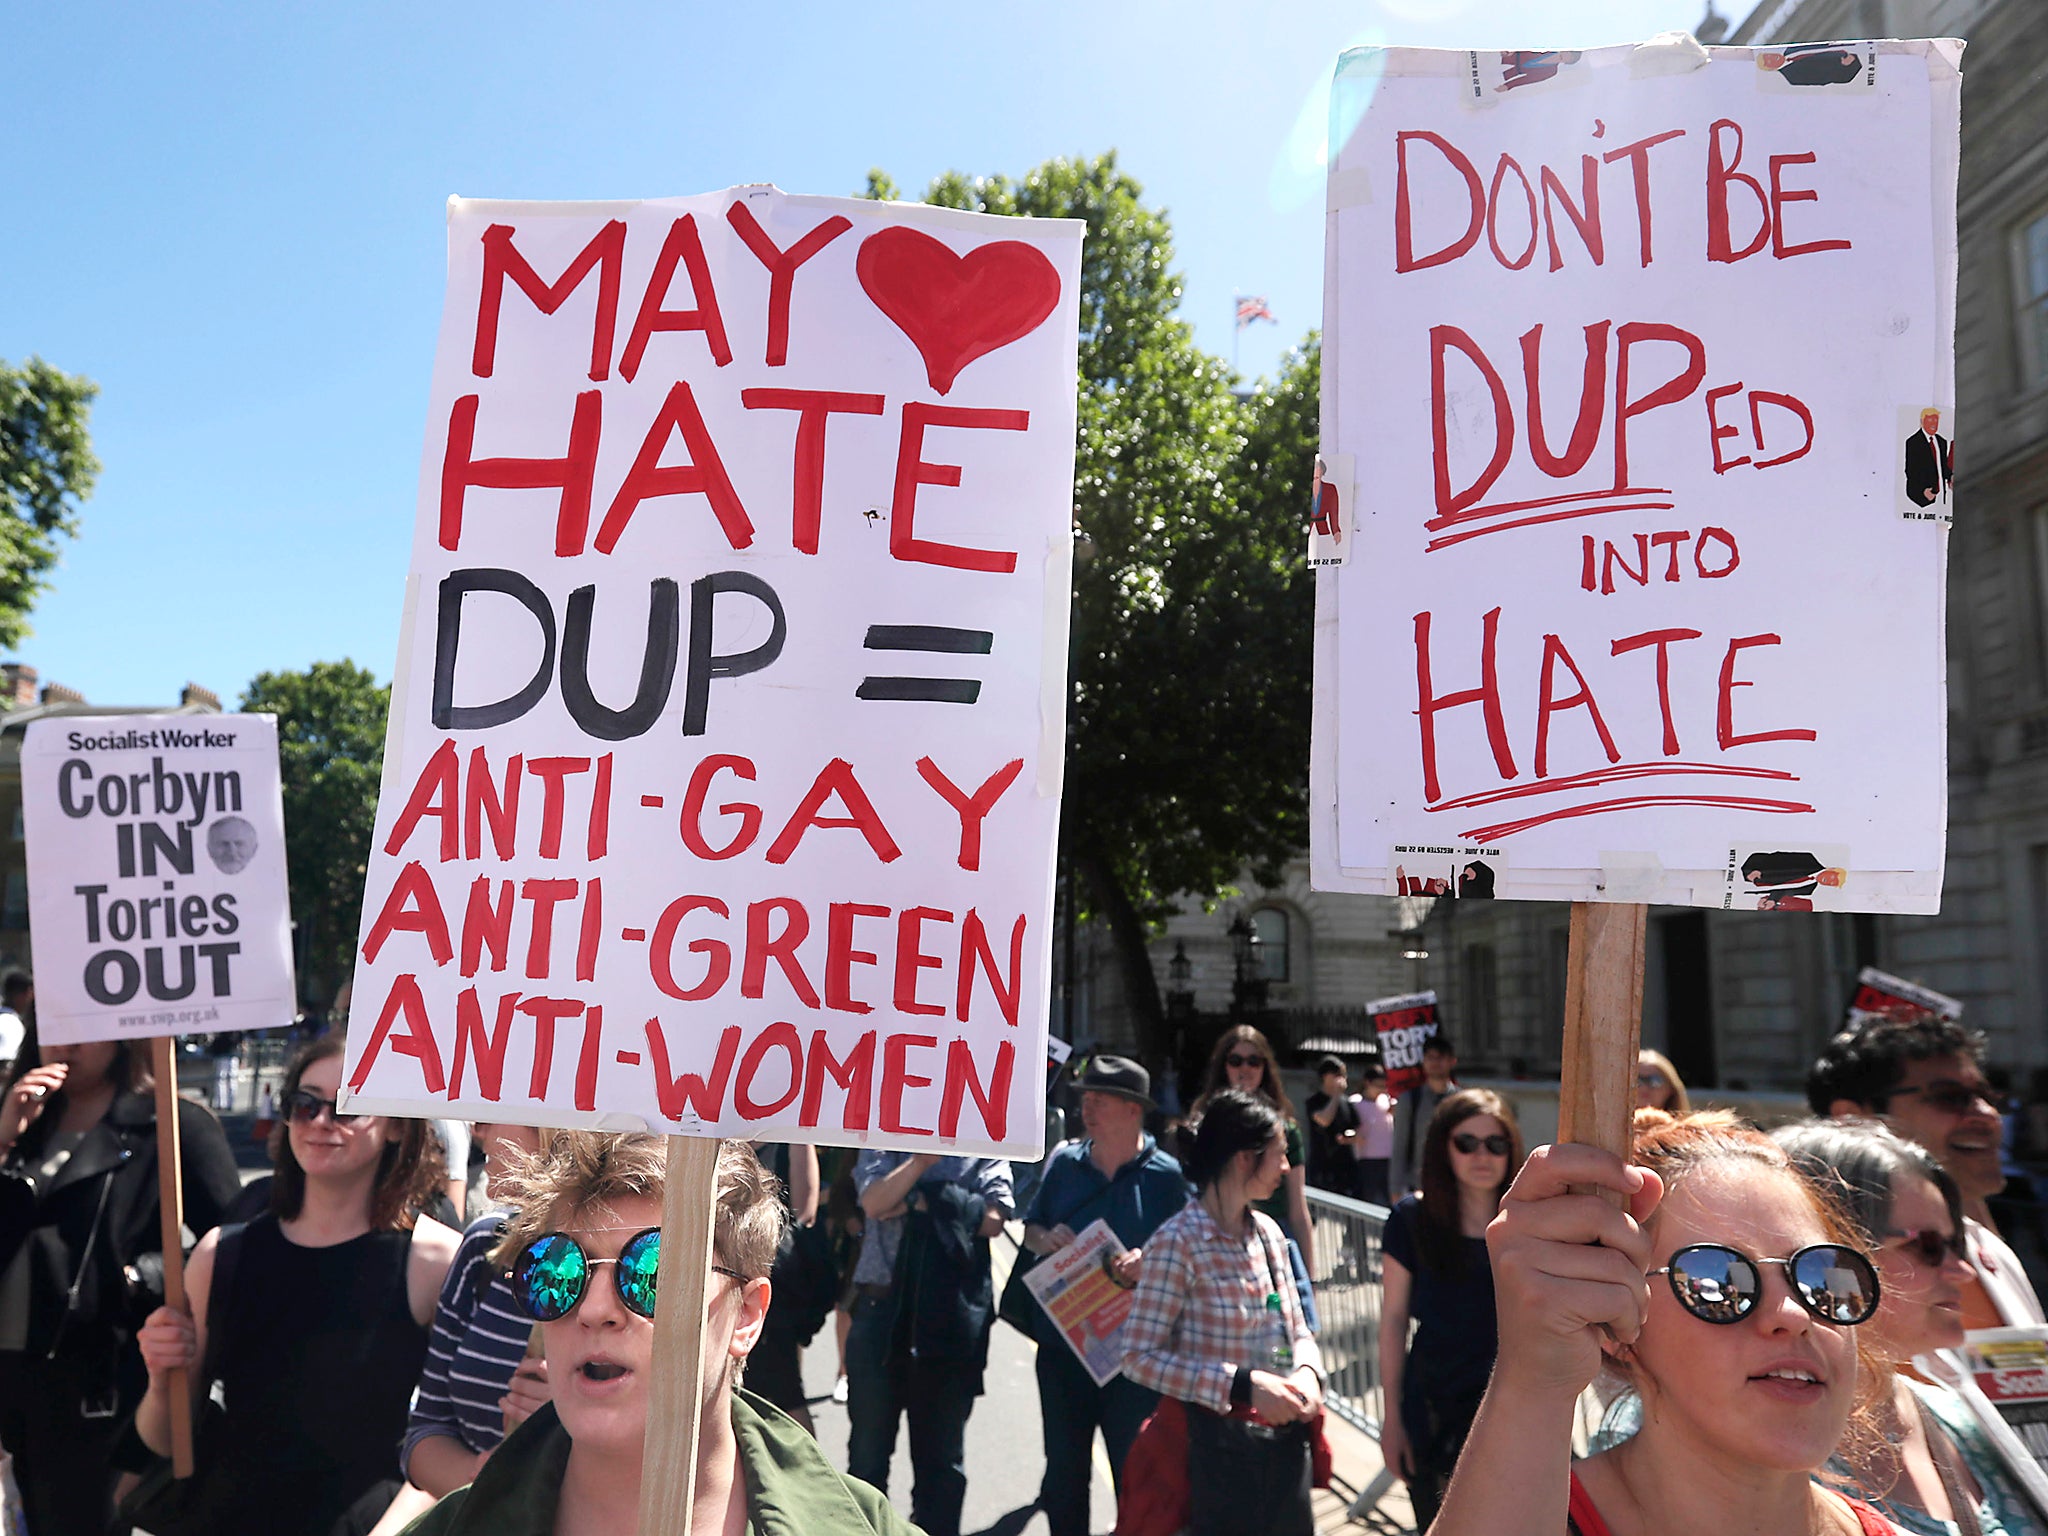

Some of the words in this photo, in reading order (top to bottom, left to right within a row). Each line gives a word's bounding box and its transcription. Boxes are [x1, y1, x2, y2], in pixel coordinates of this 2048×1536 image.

[1396, 118, 1686, 273] DON'T
[1707, 119, 1852, 265] BE
[472, 200, 853, 383] MAY
[439, 381, 1038, 573] HATE
[1581, 526, 1741, 596] INTO
[432, 568, 787, 741] DUP
[1412, 606, 1817, 803] HATE
[68, 730, 159, 750] Socialist
[160, 729, 237, 748] Worker
[58, 757, 243, 828] Corbyn
[384, 736, 1025, 873] ANTI-GAY
[116, 821, 195, 878] IN
[74, 880, 239, 943] Tories
[362, 860, 1027, 1027] ANTI-GREEN
[84, 942, 241, 1005] OUT
[118, 1008, 220, 1028] www.swp.org.uk
[348, 974, 1015, 1142] ANTI-WOMEN
[1377, 1023, 1438, 1049] TORY
